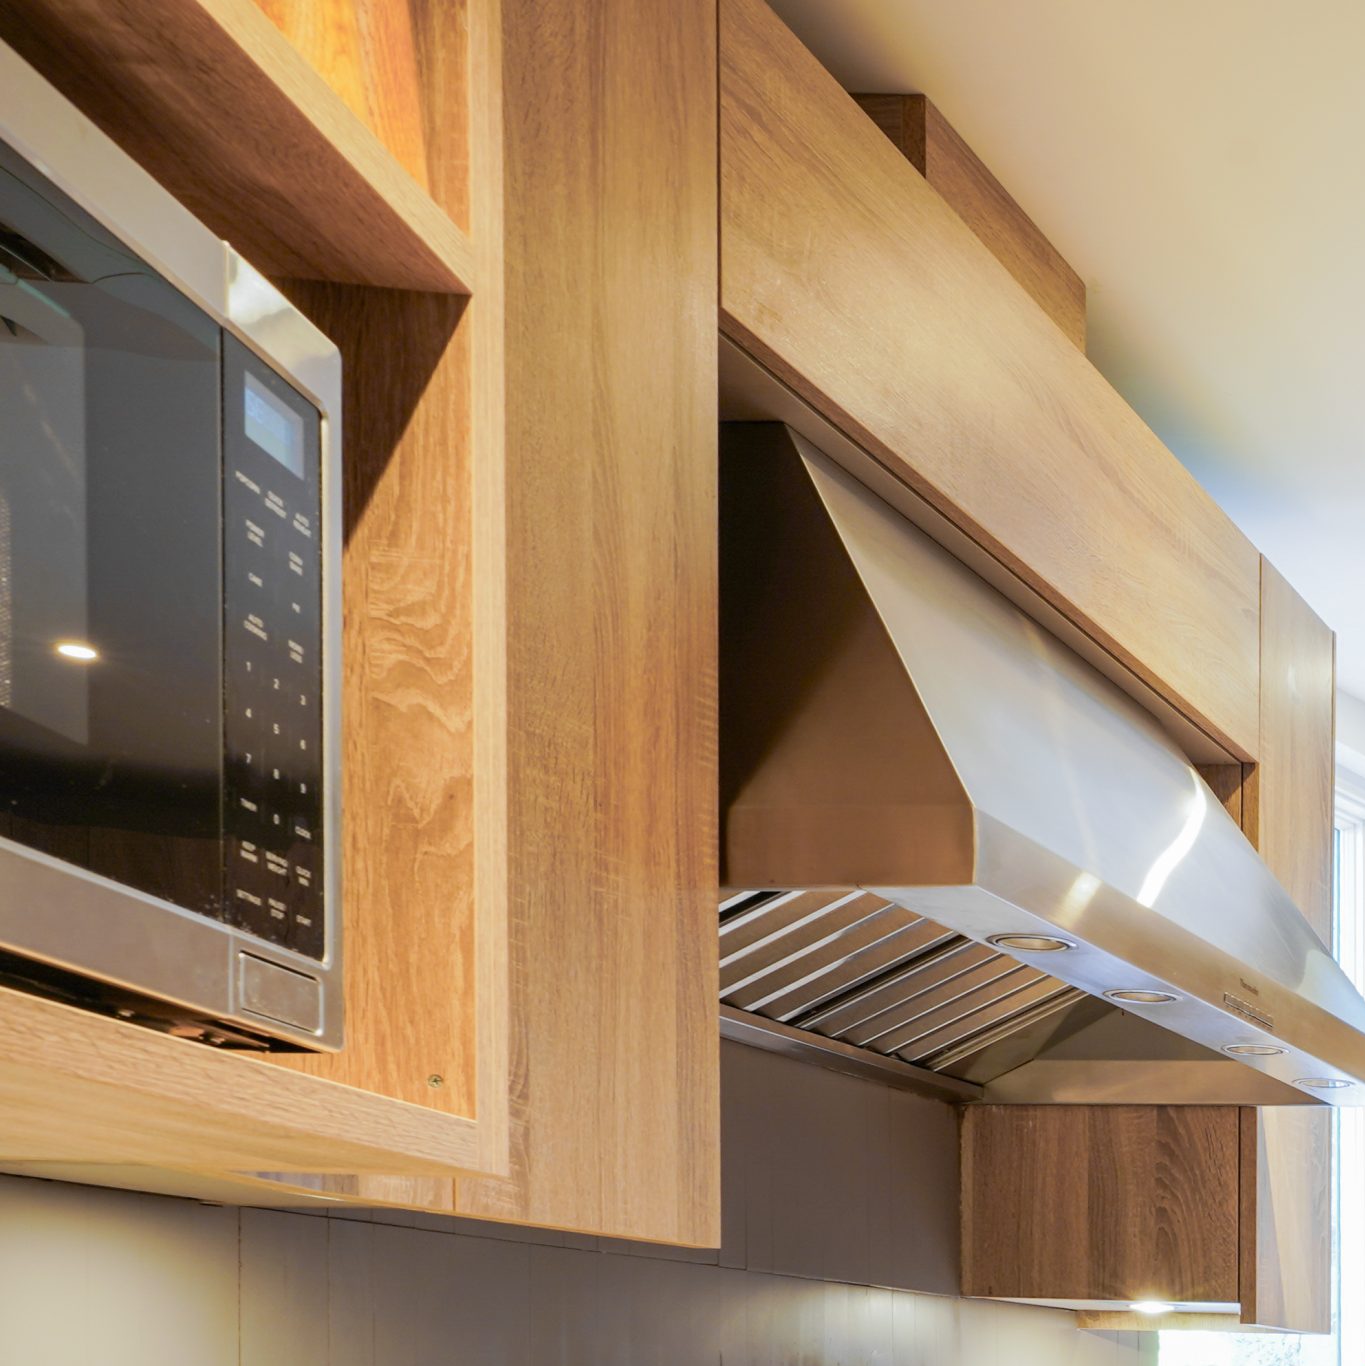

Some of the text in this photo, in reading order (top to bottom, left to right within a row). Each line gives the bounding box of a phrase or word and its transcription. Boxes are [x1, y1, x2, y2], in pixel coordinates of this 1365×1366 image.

[246, 661, 251, 672] 1
[273, 678, 279, 690] 2
[273, 723, 280, 734] 5
[245, 753, 252, 764] 7
